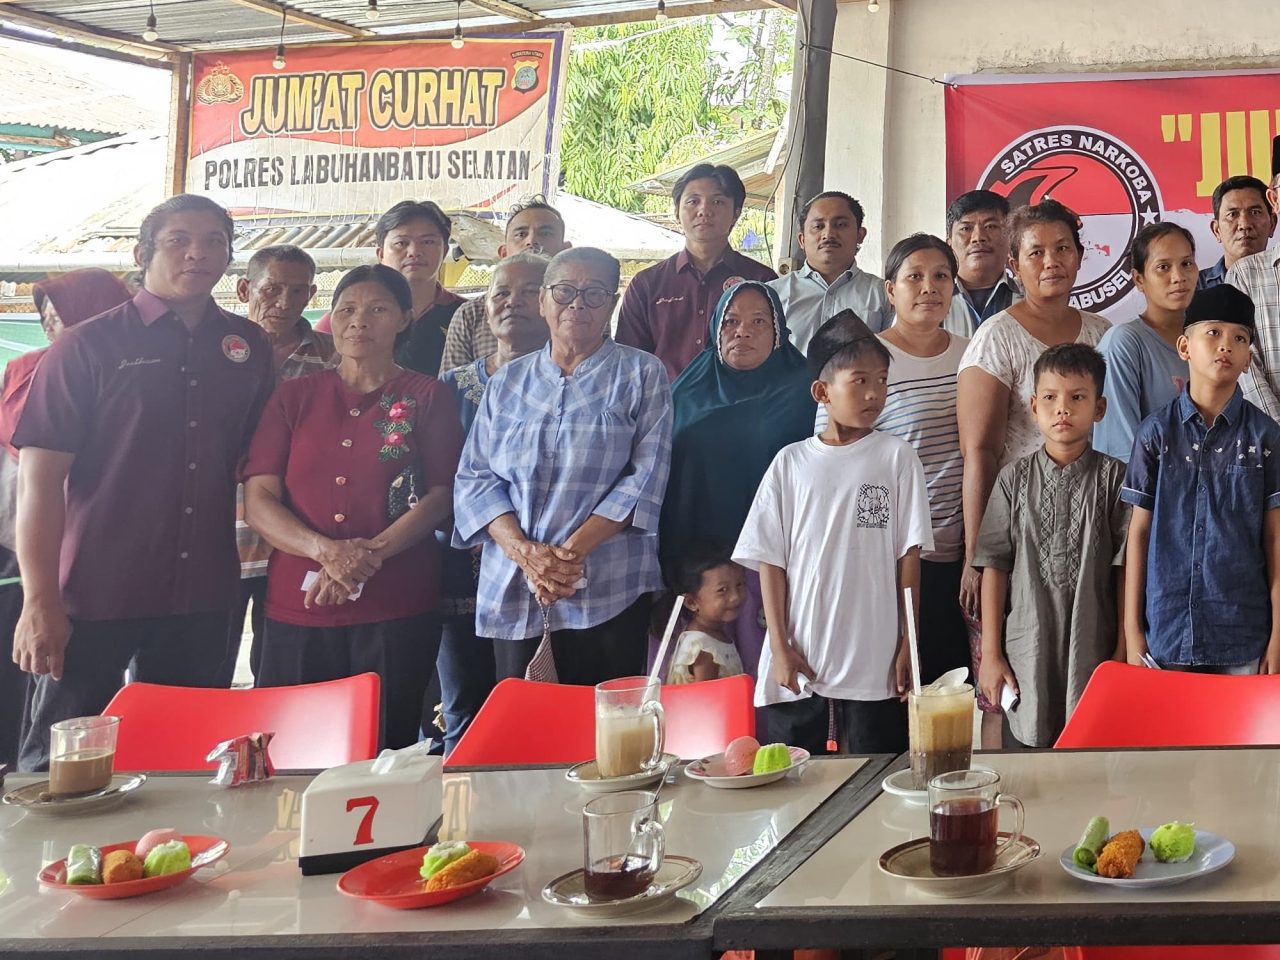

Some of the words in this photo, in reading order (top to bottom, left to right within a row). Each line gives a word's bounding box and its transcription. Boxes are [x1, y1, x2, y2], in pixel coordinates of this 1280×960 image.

[243, 72, 362, 134] JUM'AT
[369, 69, 505, 130] CURHAT
[204, 155, 284, 191] POLRES
[290, 150, 441, 186] LABUHANBATU
[447, 149, 531, 181] SELATAN
[1000, 134, 1073, 174] SATRES
[1078, 134, 1152, 204] NARKOBA
[1068, 269, 1133, 310] ABUSEL
[346, 795, 379, 846] 7
